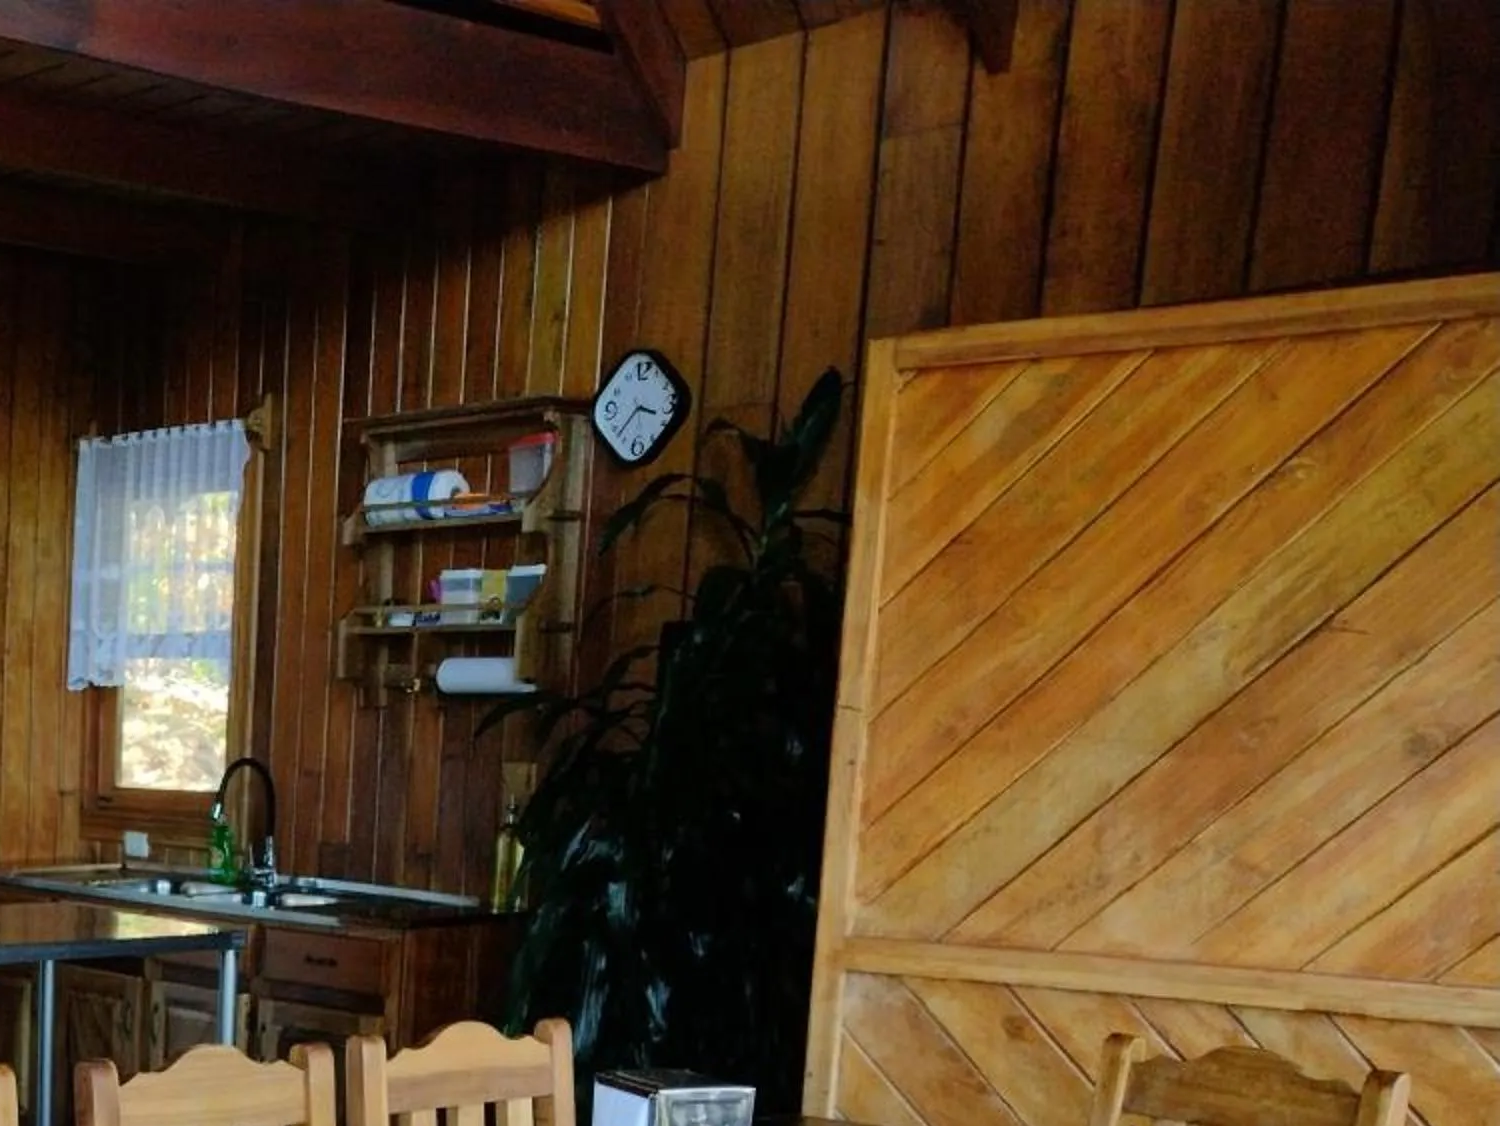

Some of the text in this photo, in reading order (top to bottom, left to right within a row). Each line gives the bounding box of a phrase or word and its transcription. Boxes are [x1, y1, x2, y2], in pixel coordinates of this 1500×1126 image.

[637, 361, 652, 381] 12
[605, 401, 617, 421] 9
[663, 394, 676, 414] 3
[631, 435, 644, 457] 6
